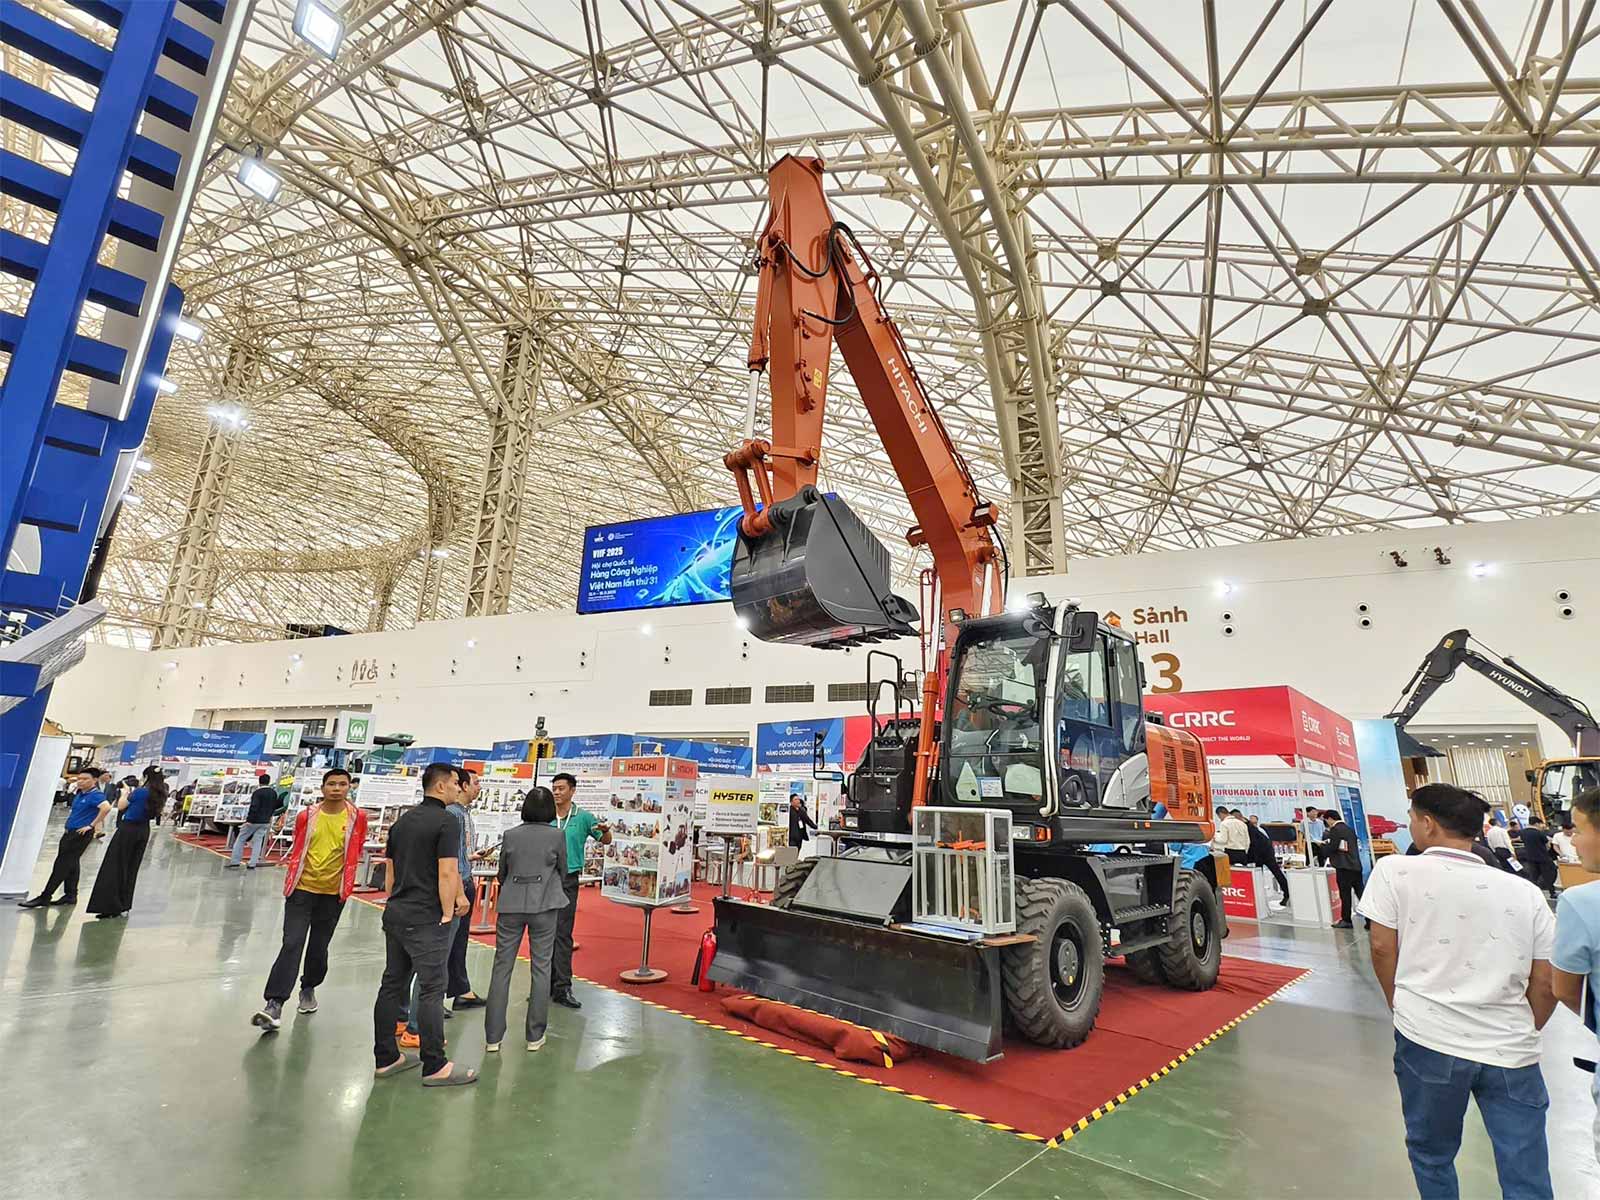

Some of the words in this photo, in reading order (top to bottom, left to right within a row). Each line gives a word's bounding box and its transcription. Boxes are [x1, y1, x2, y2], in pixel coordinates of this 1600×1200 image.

[887, 358, 928, 433] HITACHI
[606, 546, 623, 557] 2025
[605, 580, 622, 589] Nam
[649, 576, 658, 584] 31
[1133, 605, 1188, 625] Sảnh
[1134, 631, 1170, 644] Hall
[1151, 653, 1183, 694] 3
[1489, 670, 1532, 699] HYUNDAI
[1169, 710, 1236, 728] CRRC
[628, 763, 656, 771] HITACHI
[713, 792, 754, 801] HYSTER
